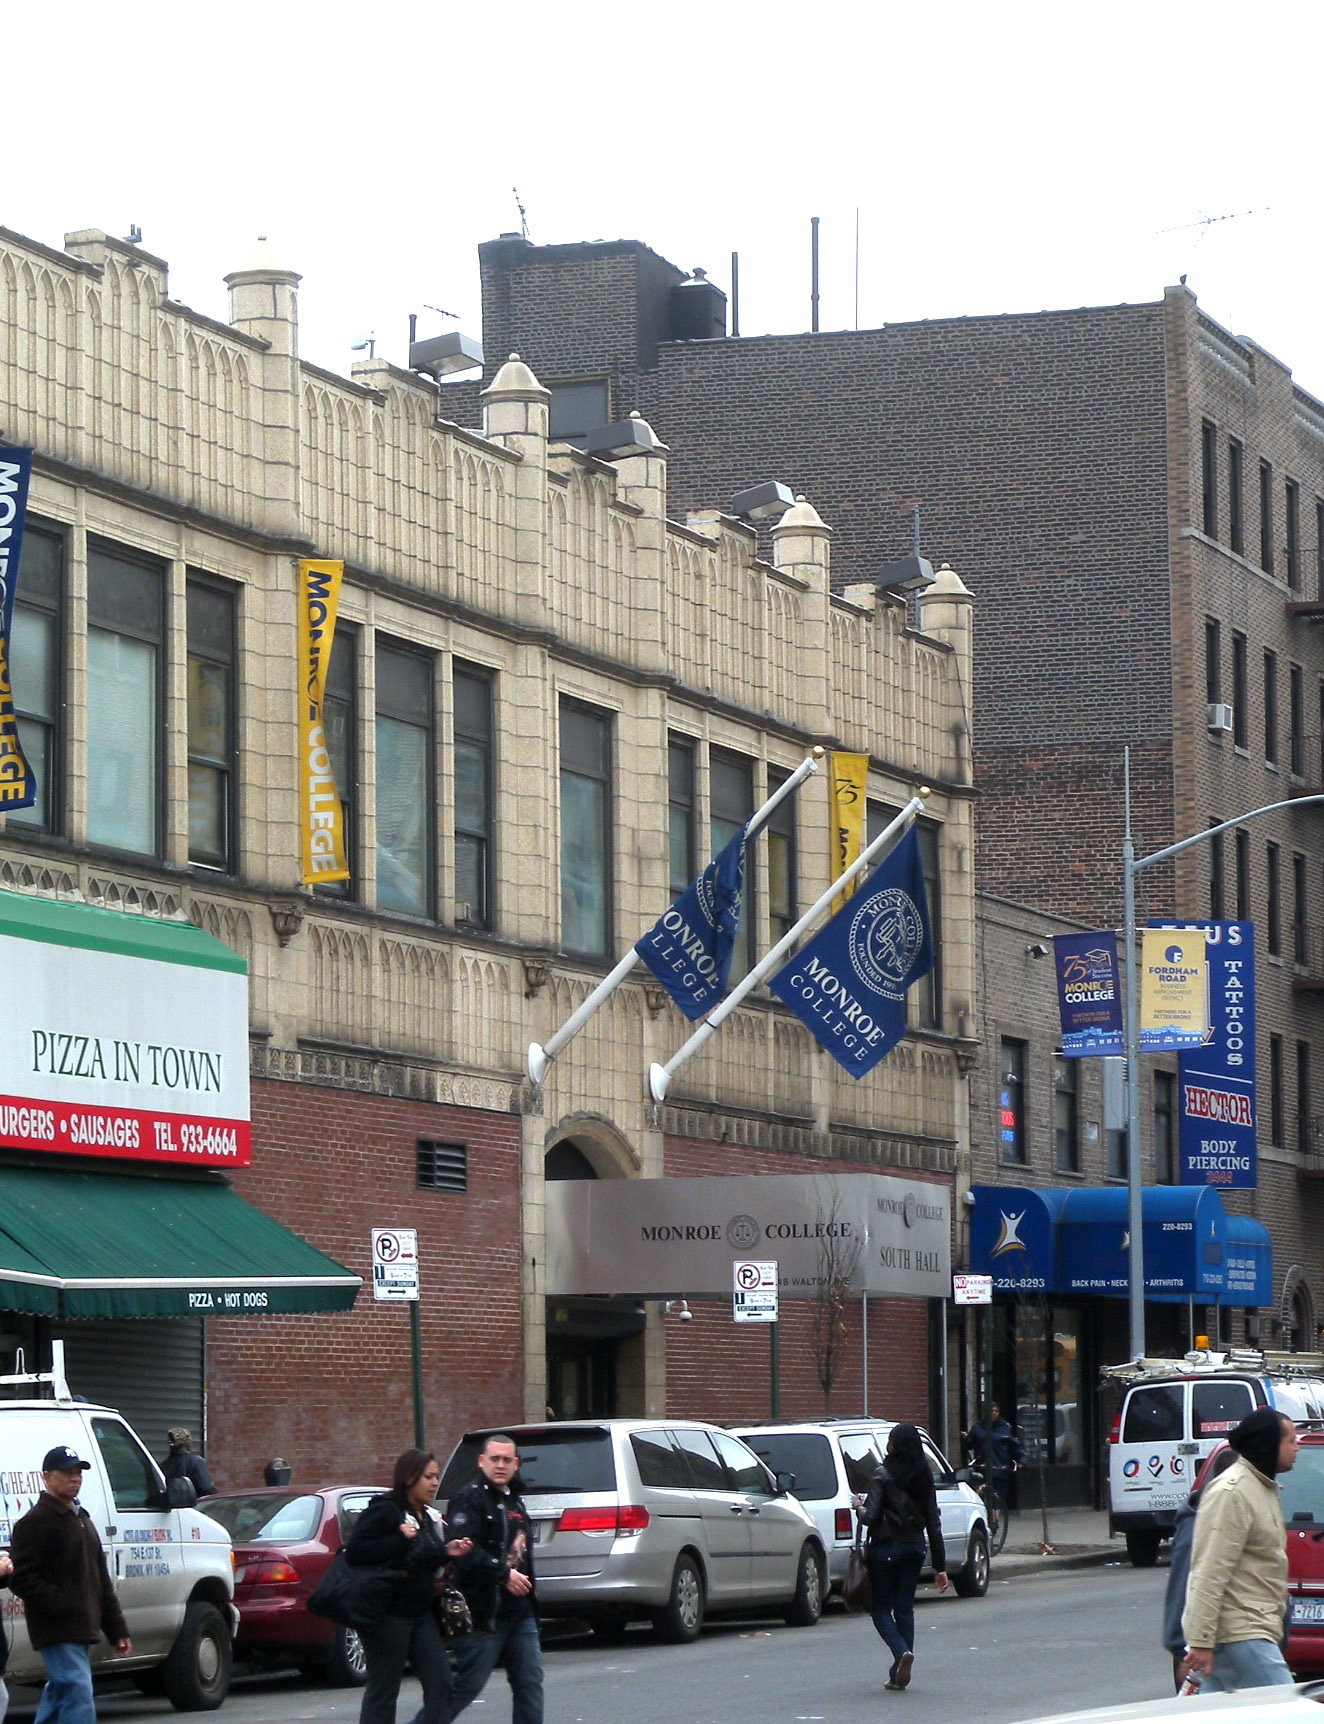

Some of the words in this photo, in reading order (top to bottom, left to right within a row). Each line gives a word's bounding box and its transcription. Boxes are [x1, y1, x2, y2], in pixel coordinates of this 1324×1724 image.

[308, 725, 338, 873] COLLEGE
[663, 904, 720, 989] ONROE
[1063, 955, 1090, 982] 75
[1148, 966, 1198, 975] FORDHAM
[1064, 980, 1114, 993] MONROE
[1158, 974, 1187, 983] ROAD
[802, 955, 886, 1047] MONROE
[1065, 989, 1115, 1003] COLLEGE
[790, 974, 868, 1060] COLLEGE
[1224, 961, 1244, 1066] TATTOOS
[32, 1030, 108, 1080] PIZZA
[114, 1041, 141, 1084] IN
[148, 1045, 222, 1093] TOWN
[1184, 1085, 1253, 1127] HECTOR
[70, 1113, 140, 1148] SAUSAGES
[153, 1121, 178, 1152] TEL.
[180, 1123, 238, 1157] 933-6664
[1200, 1140, 1237, 1154] BODY
[1187, 1156, 1250, 1170] PIERCING
[878, 1198, 904, 1216] MONROE
[916, 1203, 944, 1221] COLLEGE
[641, 1225, 722, 1241] MONROE
[765, 1222, 851, 1239] COLLEGE
[1162, 1223, 1193, 1231] 220-8293
[879, 1246, 911, 1270] SOUTH
[915, 1250, 941, 1273] HALL
[791, 1277, 831, 1286] WALTON
[955, 1277, 966, 1288] NO
[1072, 1279, 1089, 1287] BACK
[1090, 1279, 1106, 1287] PAIN
[1111, 1279, 1128, 1287] NECK
[1149, 1279, 1184, 1287] ARTHRITIS
[188, 1292, 214, 1308] PIZZA
[224, 1292, 241, 1308] HOT
[243, 1292, 268, 1307] DOGS
